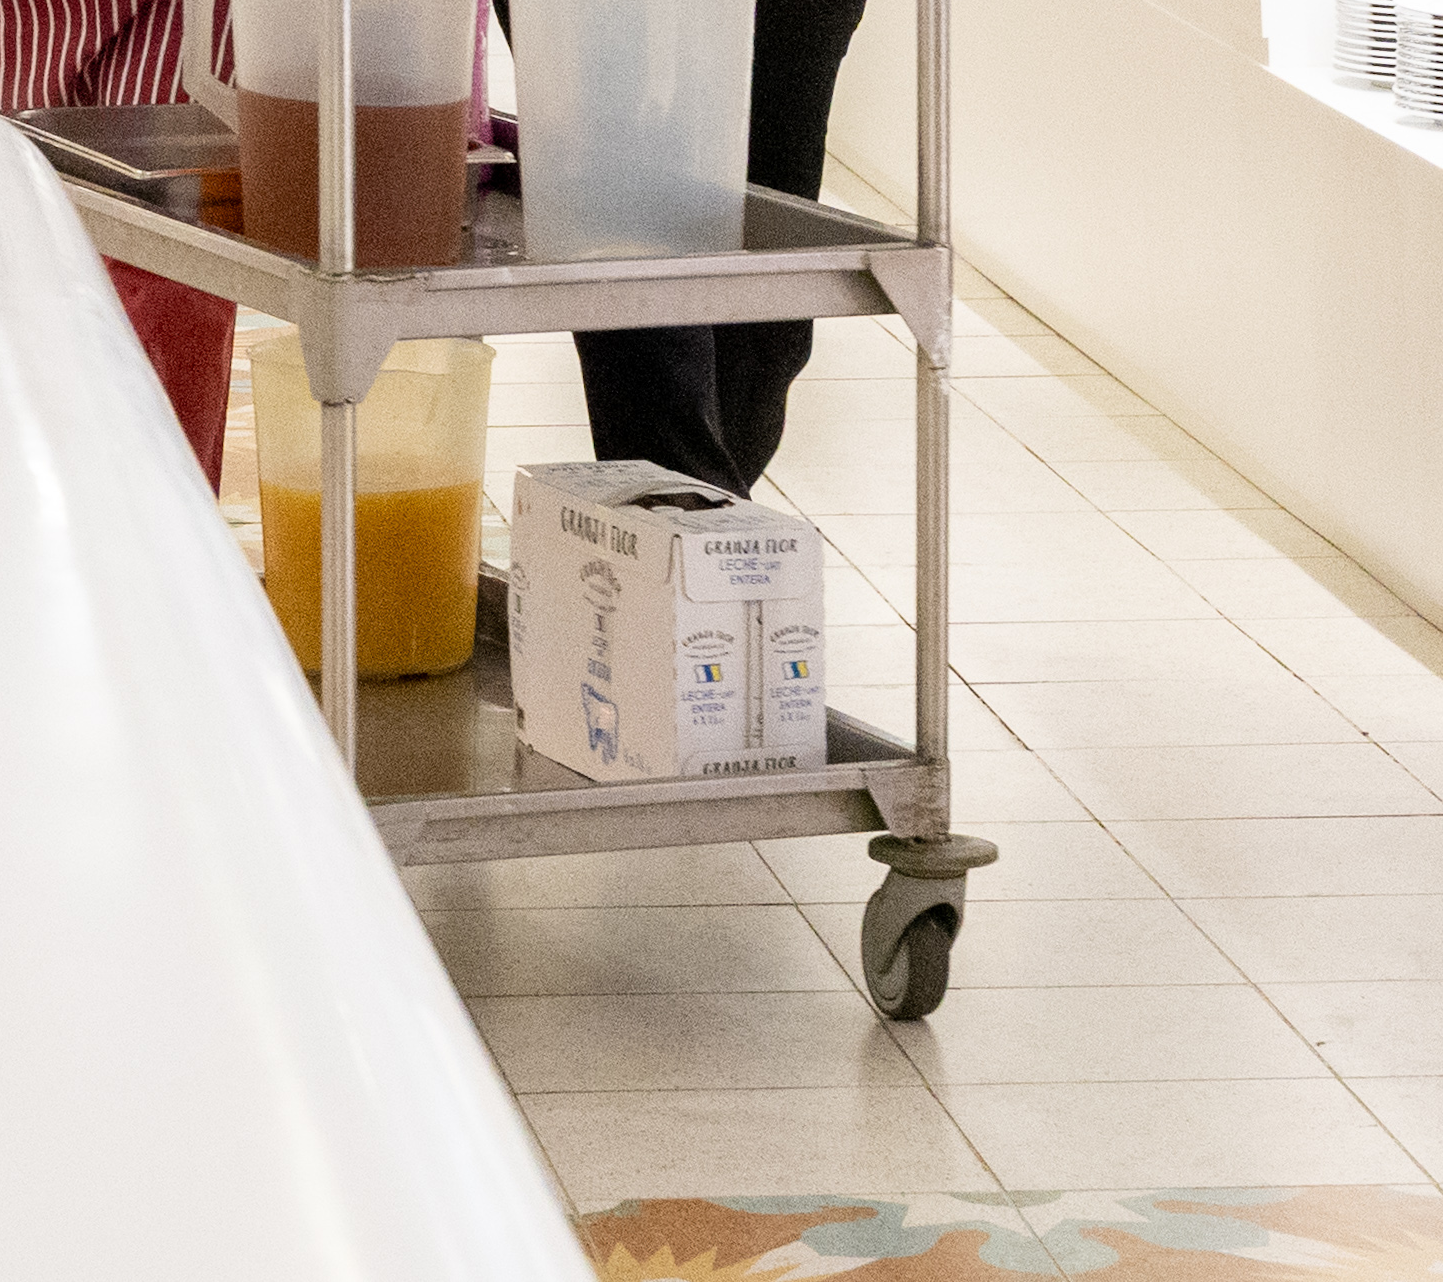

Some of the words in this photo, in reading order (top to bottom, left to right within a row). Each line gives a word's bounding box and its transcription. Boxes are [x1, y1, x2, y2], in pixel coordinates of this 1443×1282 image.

[703, 539, 760, 555] GRANJA
[764, 537, 798, 554] FLOR
[729, 574, 772, 585] ENTERA
[703, 759, 761, 775] GRANJA
[764, 755, 797, 770] FLOR
